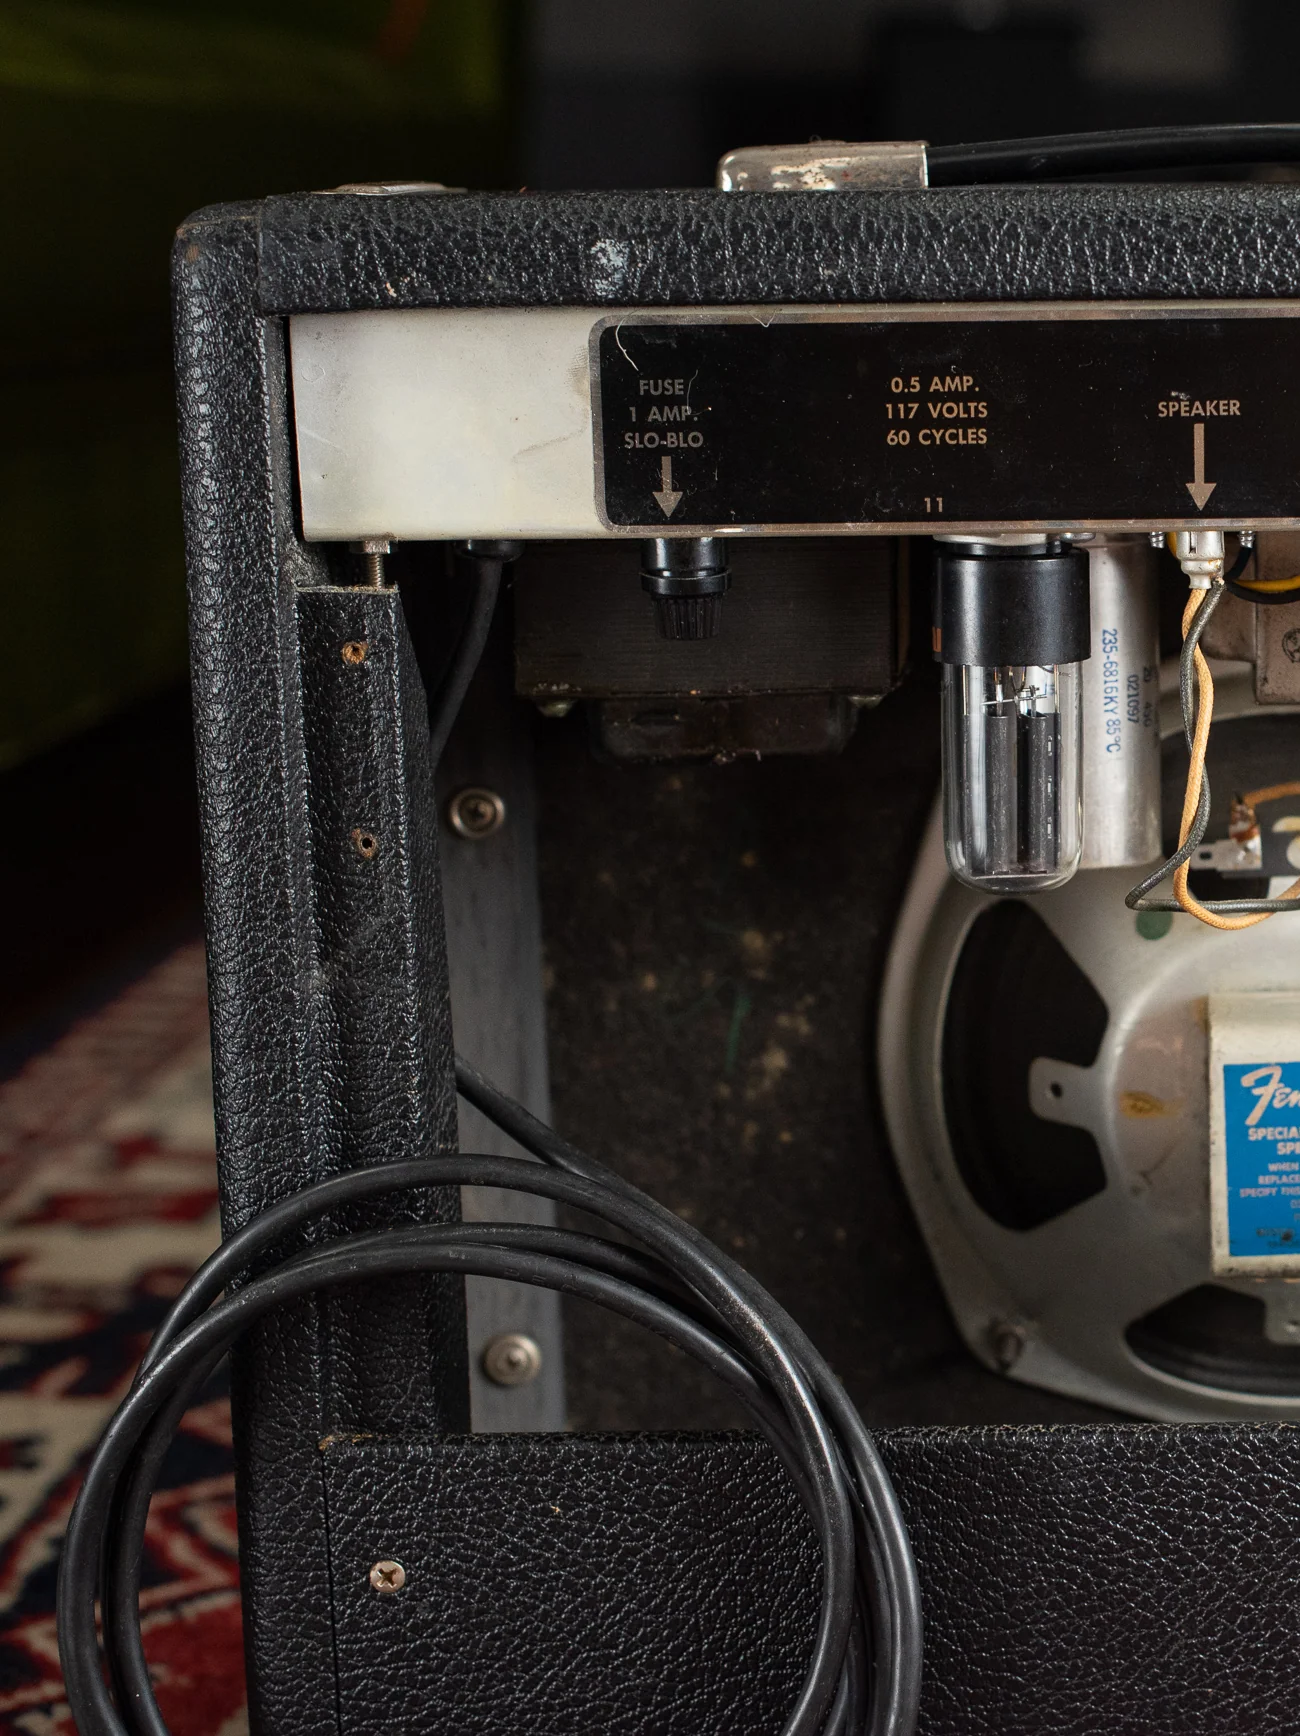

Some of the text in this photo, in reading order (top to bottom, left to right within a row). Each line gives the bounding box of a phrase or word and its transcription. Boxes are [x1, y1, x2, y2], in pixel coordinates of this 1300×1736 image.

[638, 379, 685, 396] FUSE
[891, 375, 980, 393] 0.5 AMP.
[629, 405, 699, 422] 1 AMP.
[885, 402, 989, 420] 117 VOLTS
[1157, 399, 1242, 418] SPEAKER
[623, 431, 705, 449] SLO-BLO
[886, 428, 988, 446] 60 CYCLES
[924, 496, 944, 513] 11
[1102, 628, 1122, 717] 235-6816KY
[1126, 675, 1140, 724] 021097
[1268, 1162, 1299, 1172] WHEN
